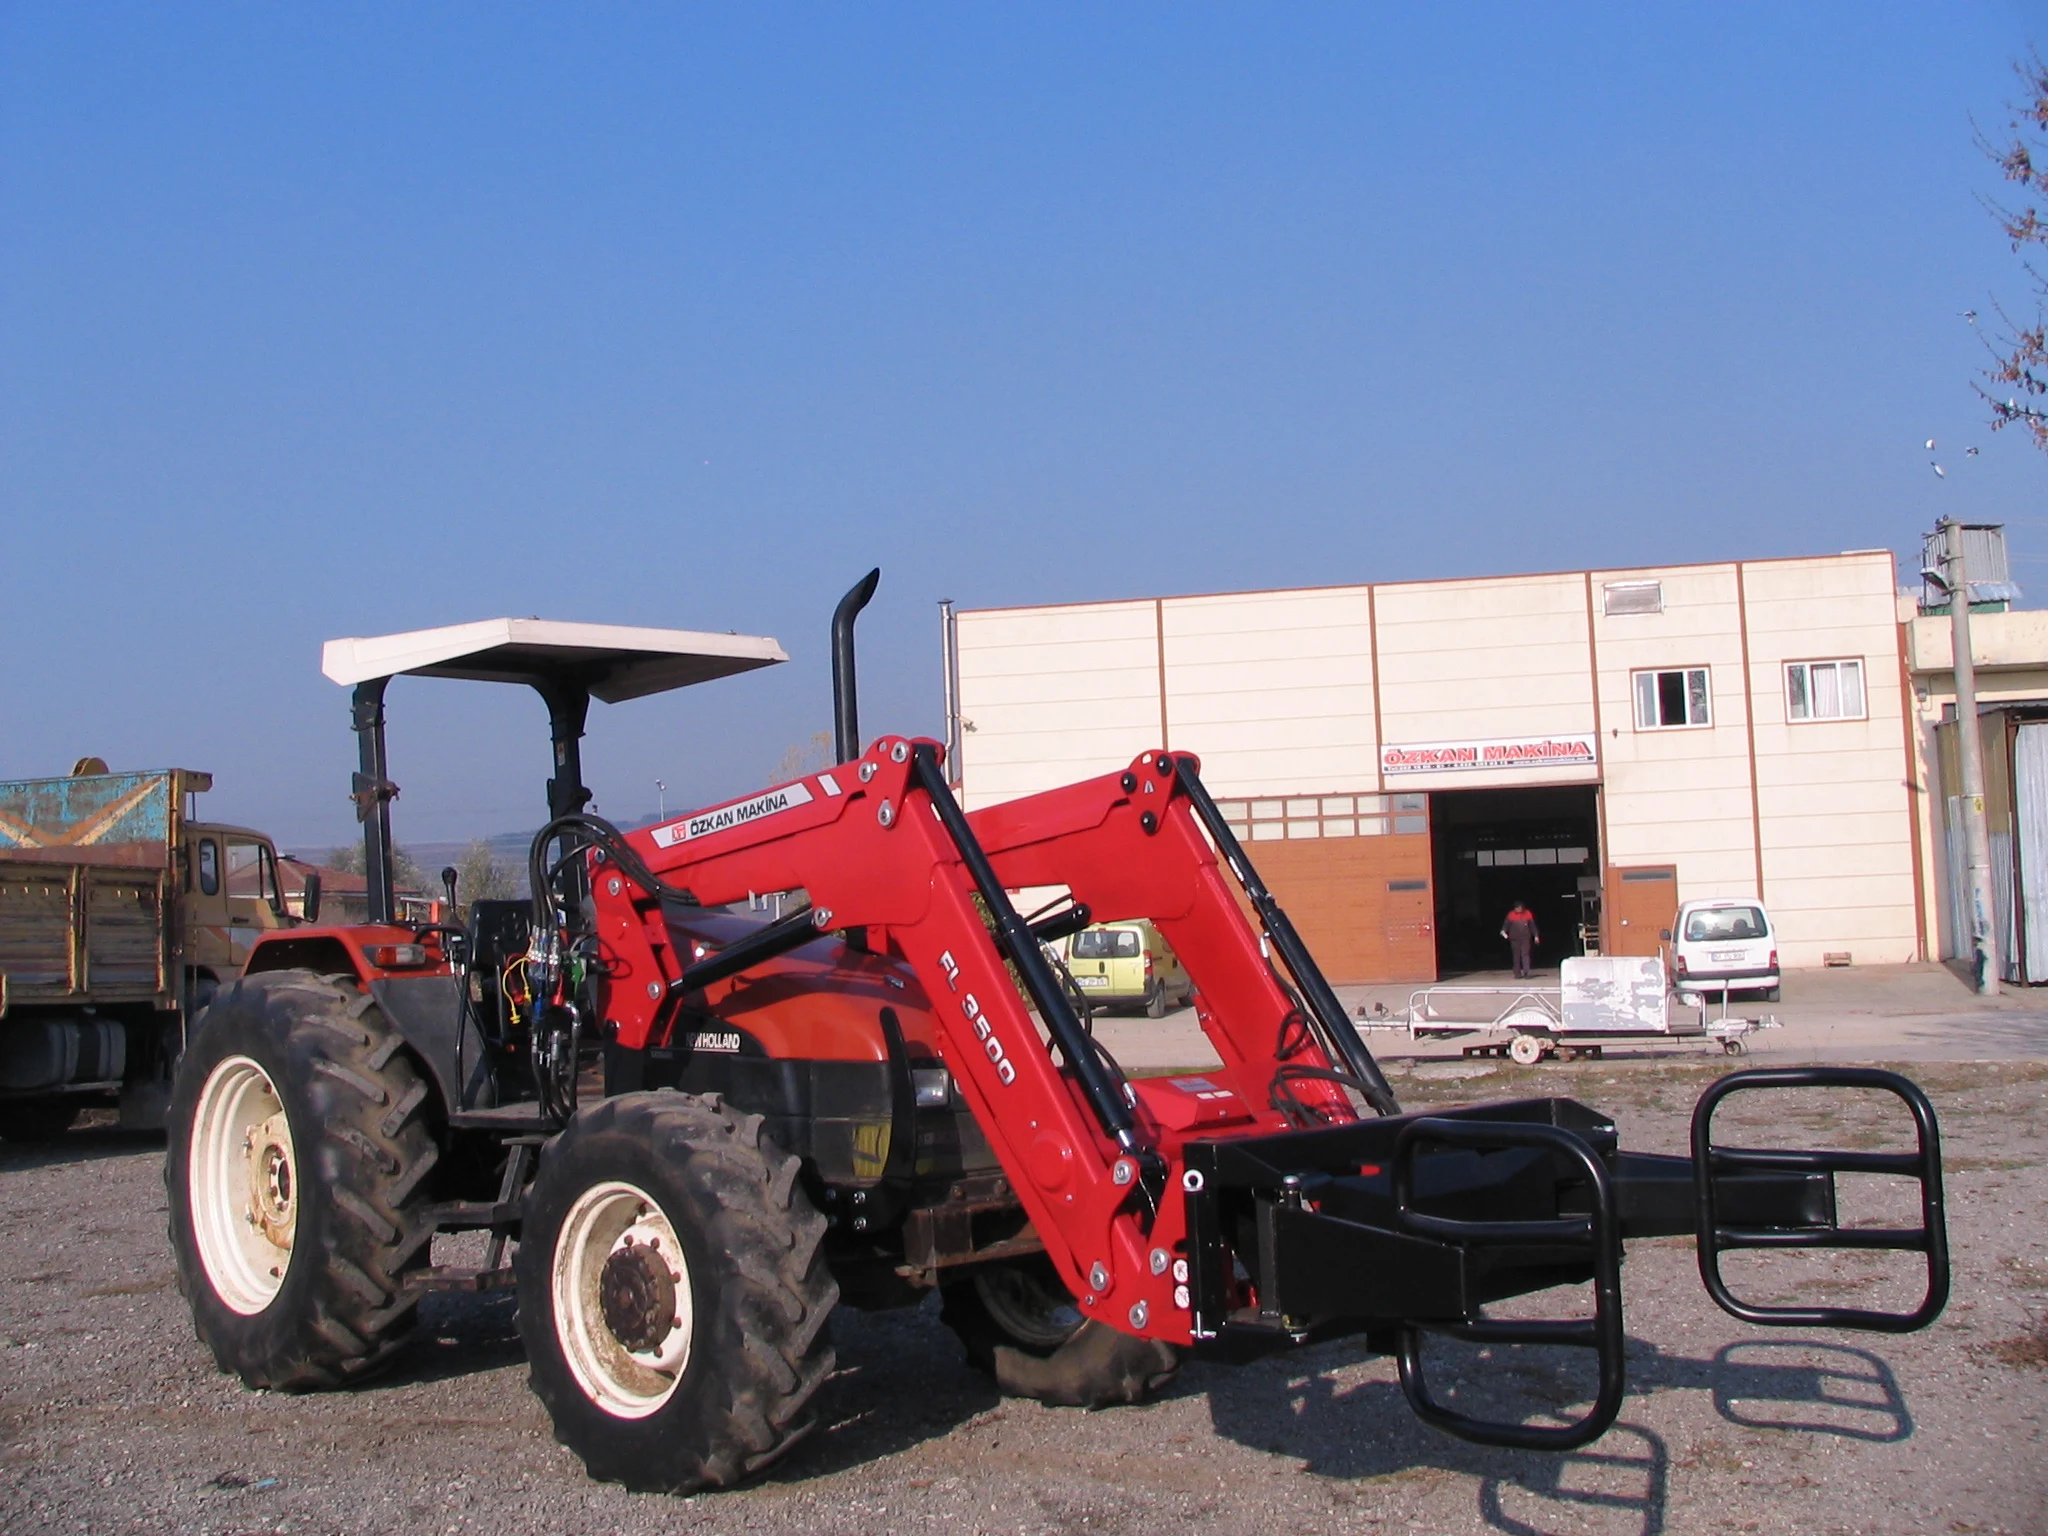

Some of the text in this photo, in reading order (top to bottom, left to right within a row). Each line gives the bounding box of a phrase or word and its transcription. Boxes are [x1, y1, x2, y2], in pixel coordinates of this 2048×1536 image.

[1384, 748, 1477, 765] ÖZKAN
[1483, 740, 1592, 760] MAKİNA
[690, 811, 734, 836] ÖZKAN
[736, 793, 788, 823] MAKİNA
[938, 950, 1016, 1086] FL 3500
[702, 1032, 740, 1049] HOLLAND
